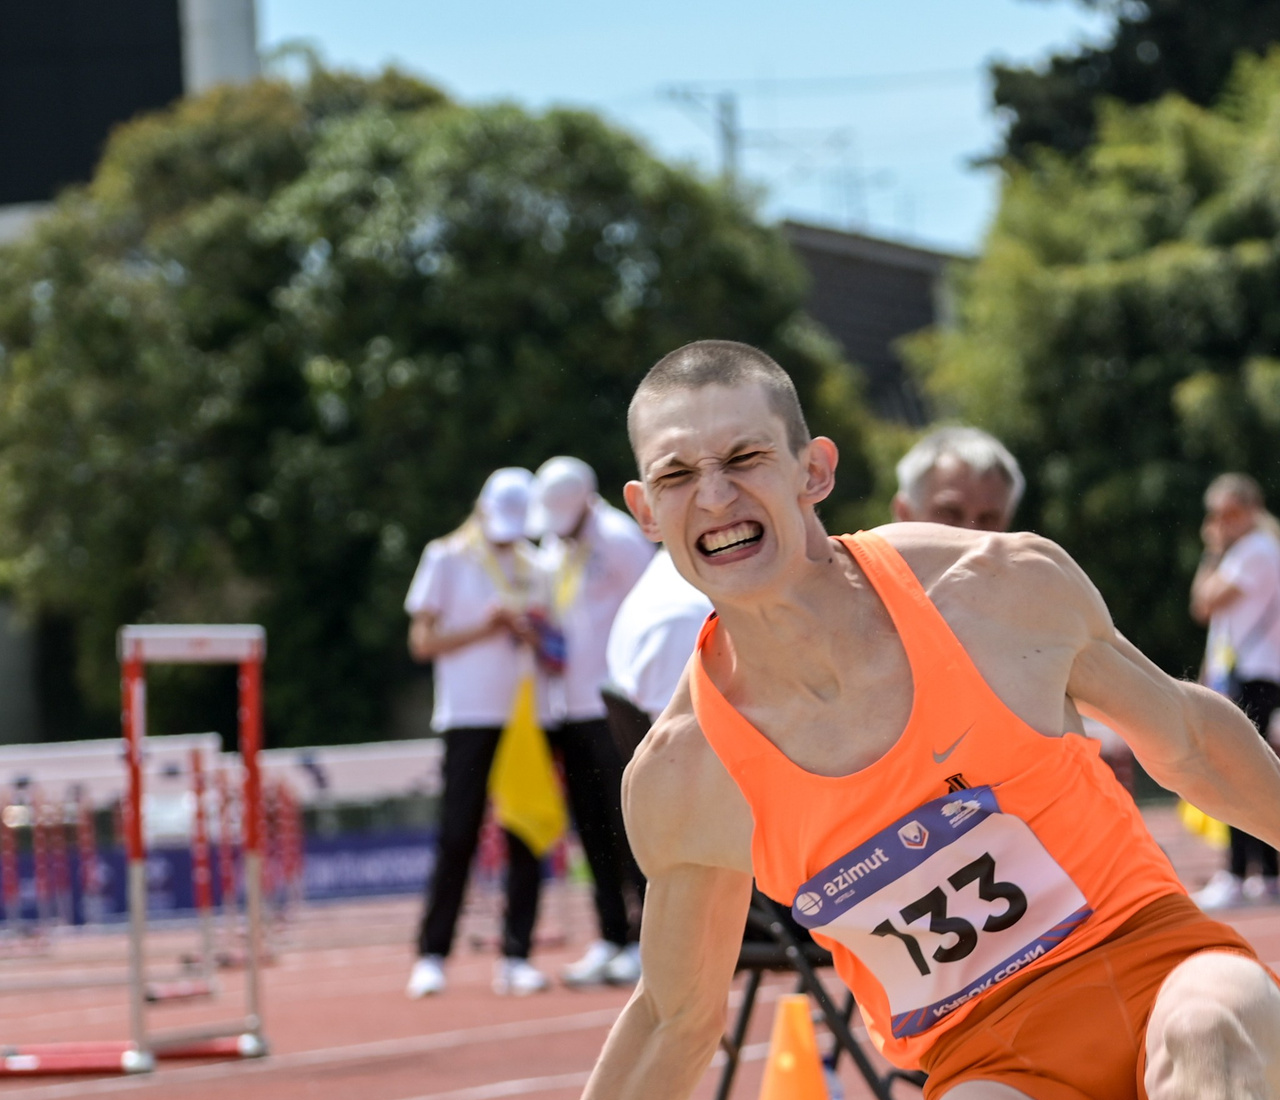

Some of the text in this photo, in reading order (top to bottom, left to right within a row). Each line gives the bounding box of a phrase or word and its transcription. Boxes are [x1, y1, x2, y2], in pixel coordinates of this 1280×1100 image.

[823, 847, 889, 896] azimut
[869, 852, 1028, 977] 133
[994, 944, 1046, 983] СОЧИ
